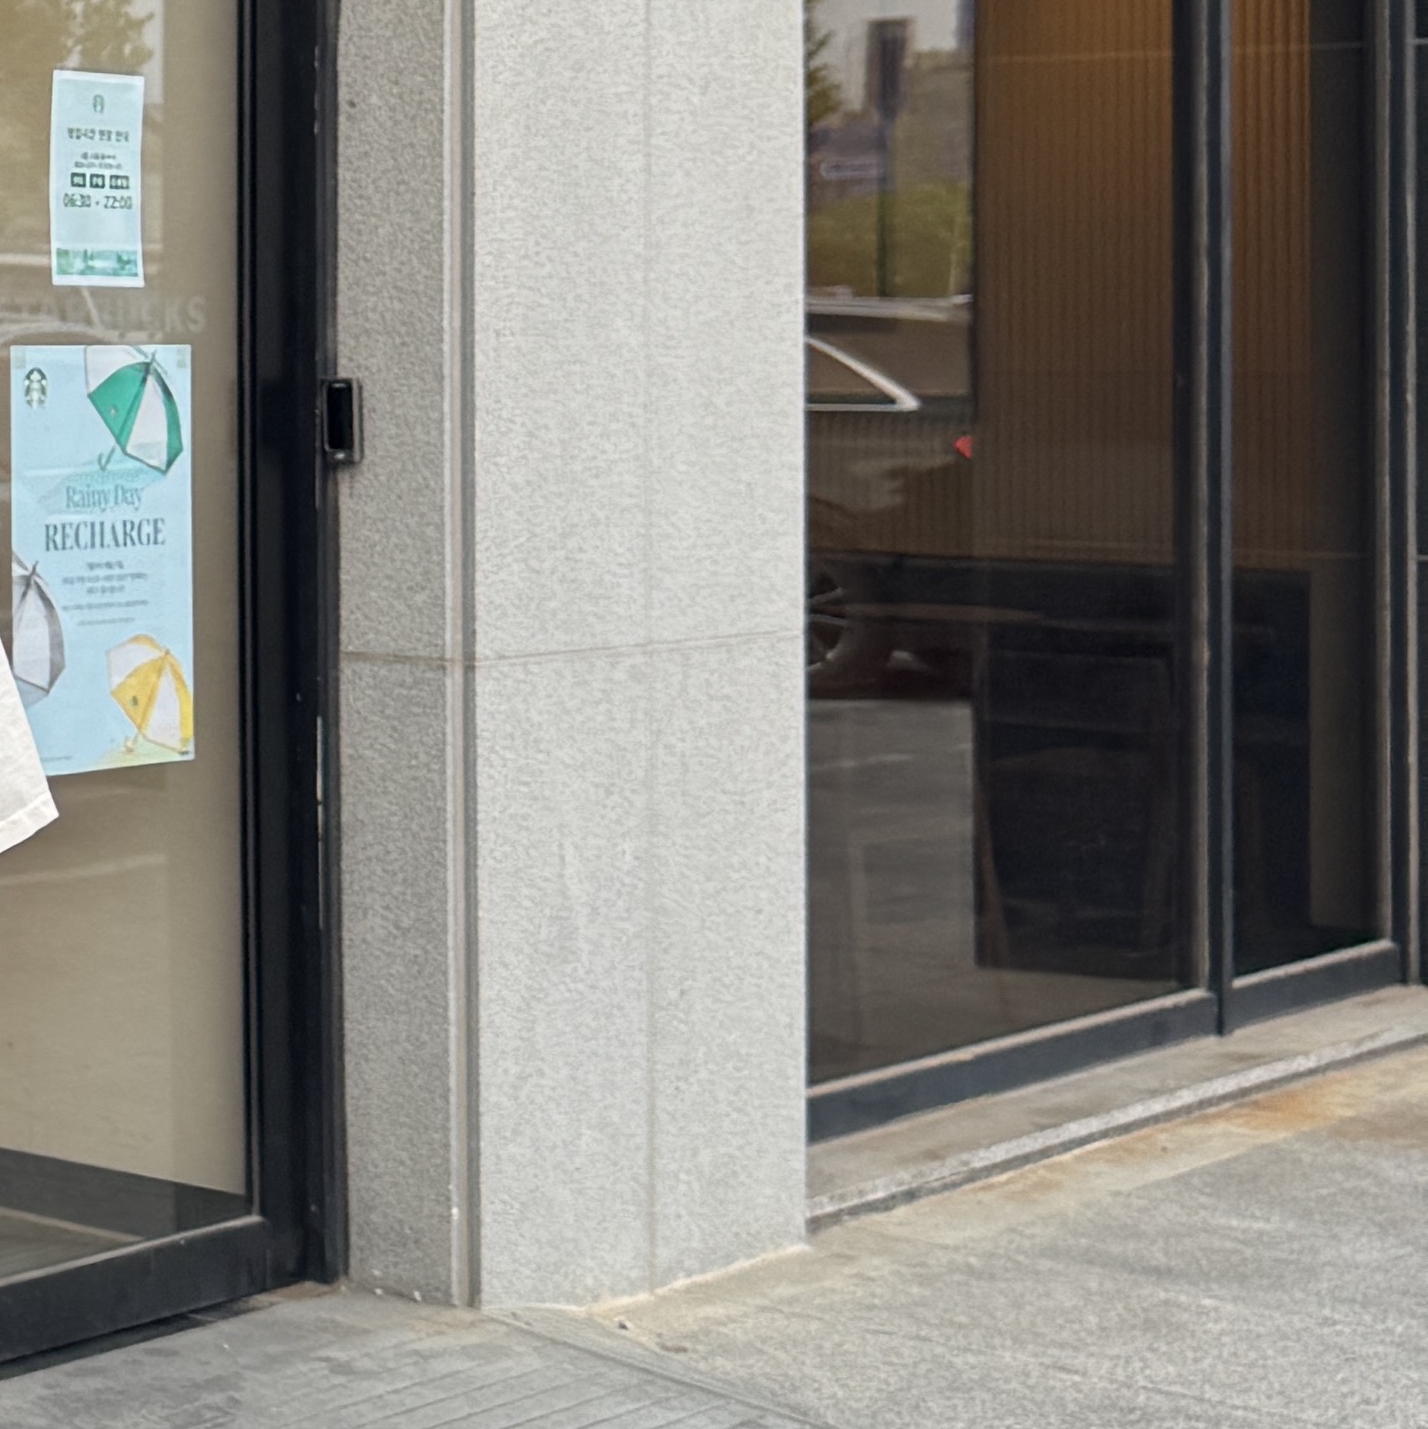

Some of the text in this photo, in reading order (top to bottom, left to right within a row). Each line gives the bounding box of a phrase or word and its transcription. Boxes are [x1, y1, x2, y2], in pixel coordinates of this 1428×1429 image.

[66, 484, 144, 512] Rainy Day
[45, 517, 166, 551] RECHARGE
